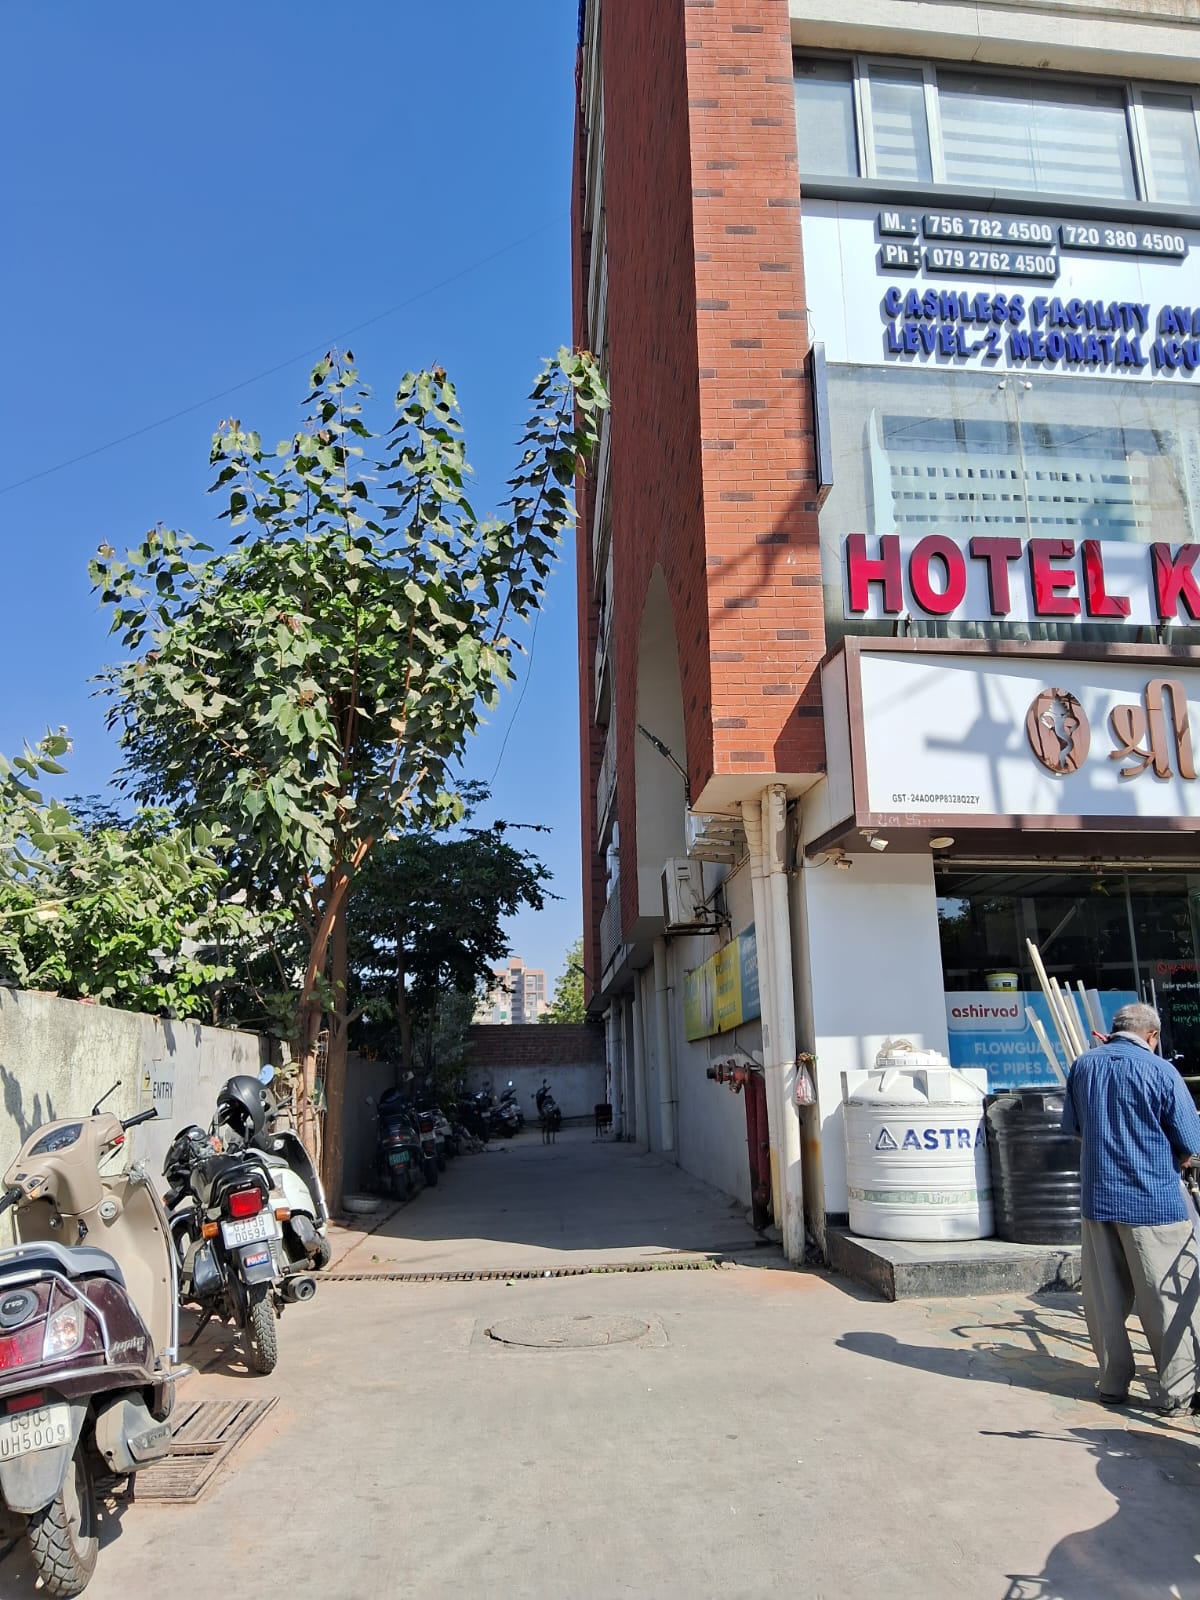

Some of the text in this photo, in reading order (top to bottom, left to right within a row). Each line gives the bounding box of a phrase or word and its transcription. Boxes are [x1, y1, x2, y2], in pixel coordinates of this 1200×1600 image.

[884, 212, 906, 230] M.
[930, 215, 963, 235] 756
[969, 218, 1003, 238] 782
[1008, 222, 1053, 241] 4500
[1066, 225, 1099, 245] 720
[1105, 228, 1137, 248] 380
[1142, 232, 1185, 253] 4500
[886, 245, 909, 263] Ph
[933, 248, 965, 267] 079
[969, 251, 1010, 271] 2762
[1015, 255, 1056, 274] 4500
[884, 286, 1026, 325] CASHLESS
[1032, 296, 1151, 333] FACILITY
[886, 322, 1200, 371] LEVEL-2 NEONATAL ICU
[846, 533, 1132, 618] HOTEL
[951, 1004, 1019, 1018] ashirvad
[974, 1042, 1064, 1055] FLOWGUAD
[1003, 1062, 1041, 1075] PIPES
[152, 1081, 174, 1099] ENTRY
[4, 1299, 25, 1309] TVS
[1, 1423, 66, 1456] UH5009
